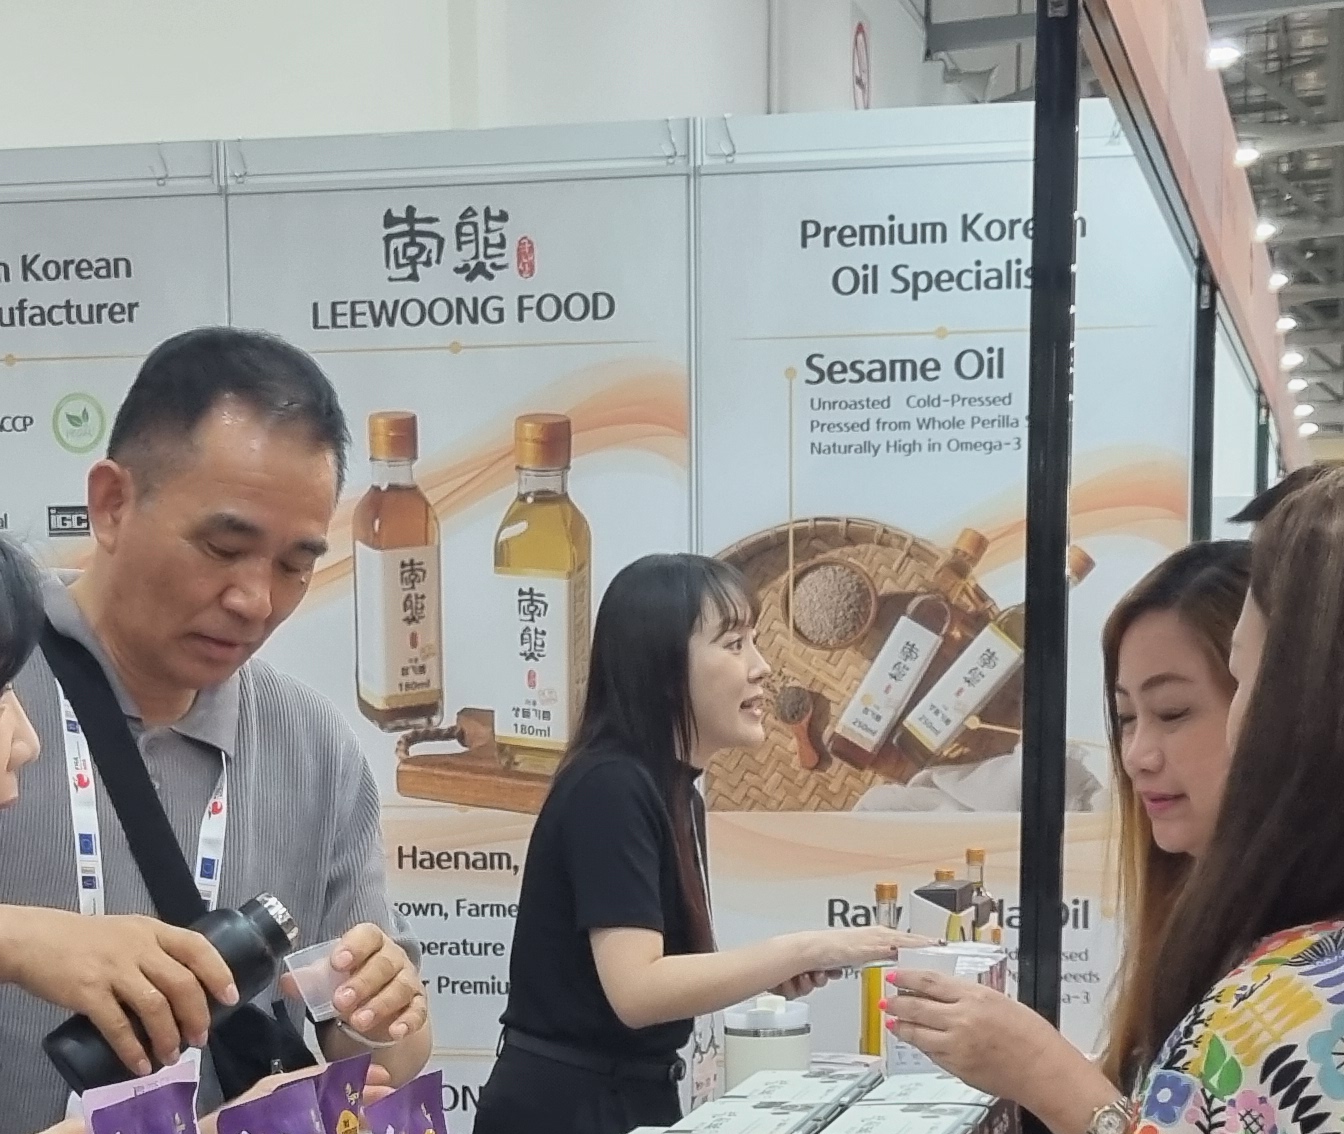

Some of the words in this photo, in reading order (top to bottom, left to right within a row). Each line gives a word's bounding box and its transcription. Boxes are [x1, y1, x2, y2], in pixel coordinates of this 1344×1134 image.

[800, 215, 948, 249] Premium
[960, 212, 1087, 242] Koren
[21, 253, 132, 282] Korean
[832, 264, 879, 296] Oil
[890, 258, 1035, 300] Specialis
[312, 295, 505, 331] LEEWOONG
[518, 290, 616, 324] FOOD
[805, 352, 941, 386] Sesame
[954, 347, 1005, 381] Oil
[810, 396, 891, 411] Unroasted
[906, 393, 1012, 409] Cold-Pressed
[810, 418, 870, 433] Pressed
[875, 417, 912, 432] from
[916, 415, 966, 431] Whole
[970, 414, 1019, 429] Perilla
[810, 440, 881, 457] Naturally
[886, 439, 923, 456] High
[927, 439, 942, 453] in
[947, 437, 1022, 455] Omega-3
[513, 723, 551, 738] 180ml
[397, 845, 519, 876] Haenam,
[394, 902, 449, 921] own,
[456, 898, 519, 918] Farme
[420, 938, 505, 957] erature
[437, 976, 511, 996] Premiu
